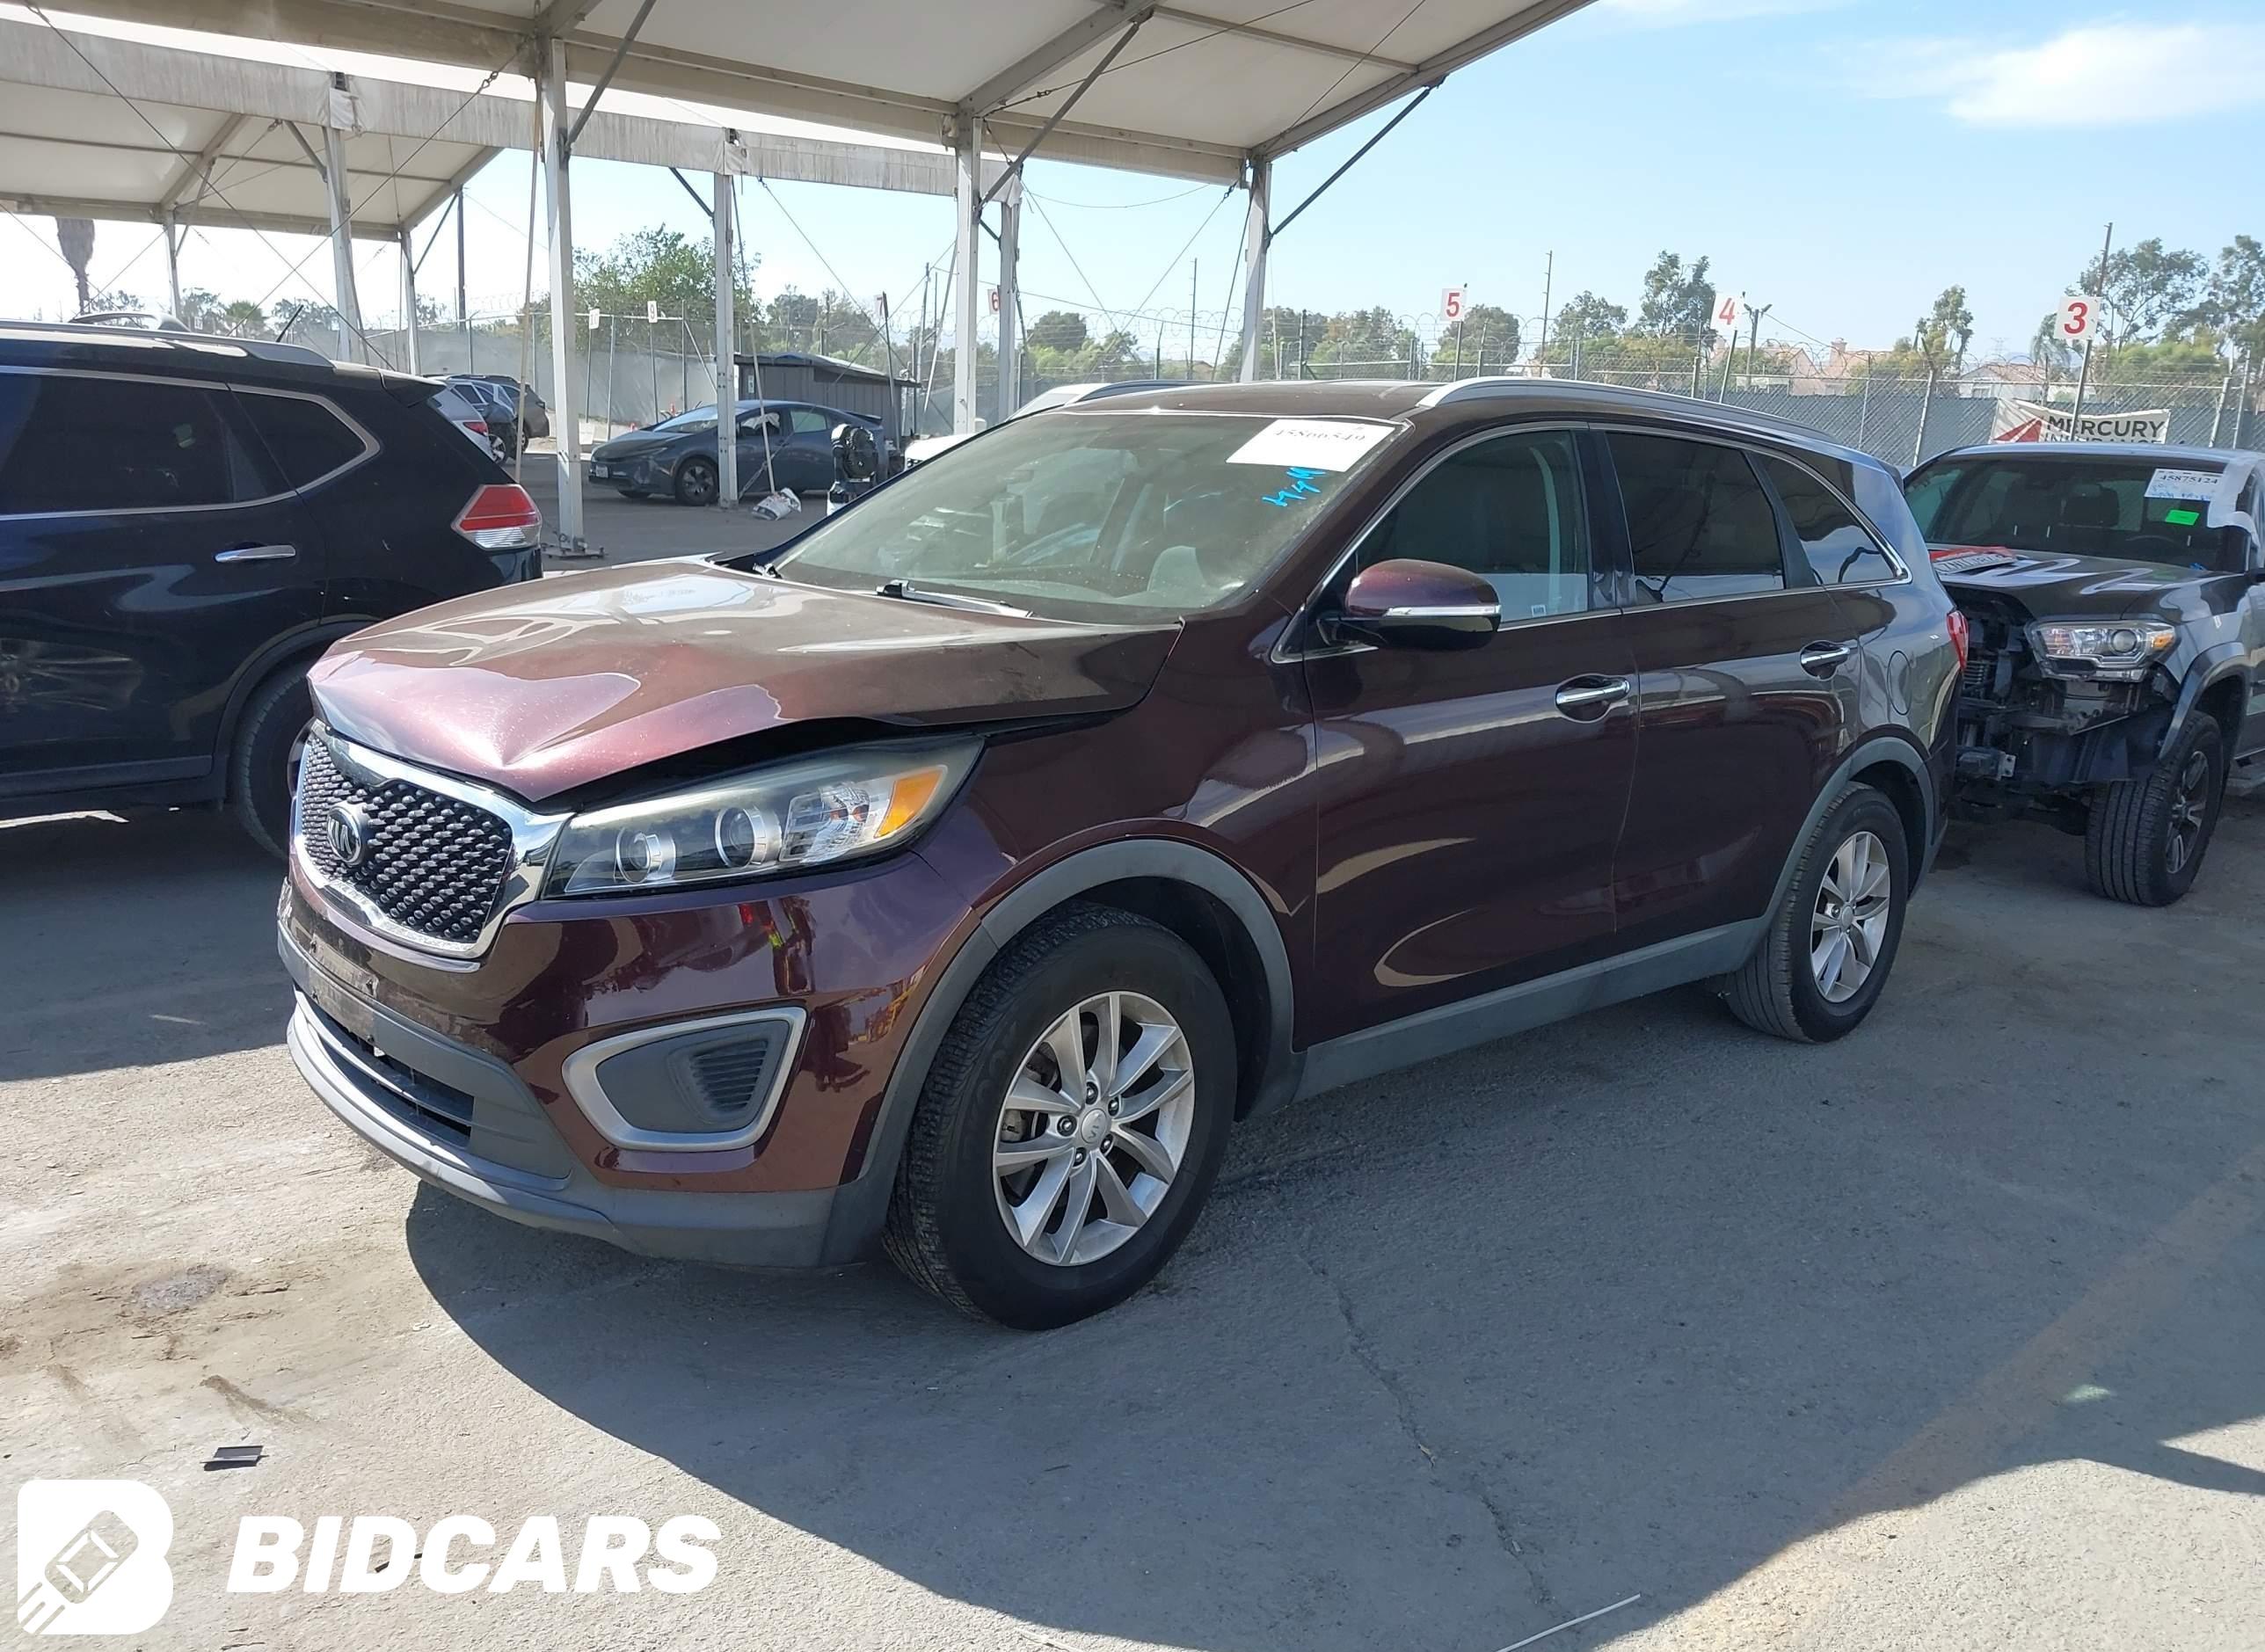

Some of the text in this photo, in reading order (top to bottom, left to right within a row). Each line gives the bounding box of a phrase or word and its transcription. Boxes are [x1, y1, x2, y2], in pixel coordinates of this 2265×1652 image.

[1446, 292, 1460, 317] 5
[1718, 297, 1735, 325] 4
[2064, 302, 2088, 334] 3
[2047, 415, 2165, 438] MERCURY
